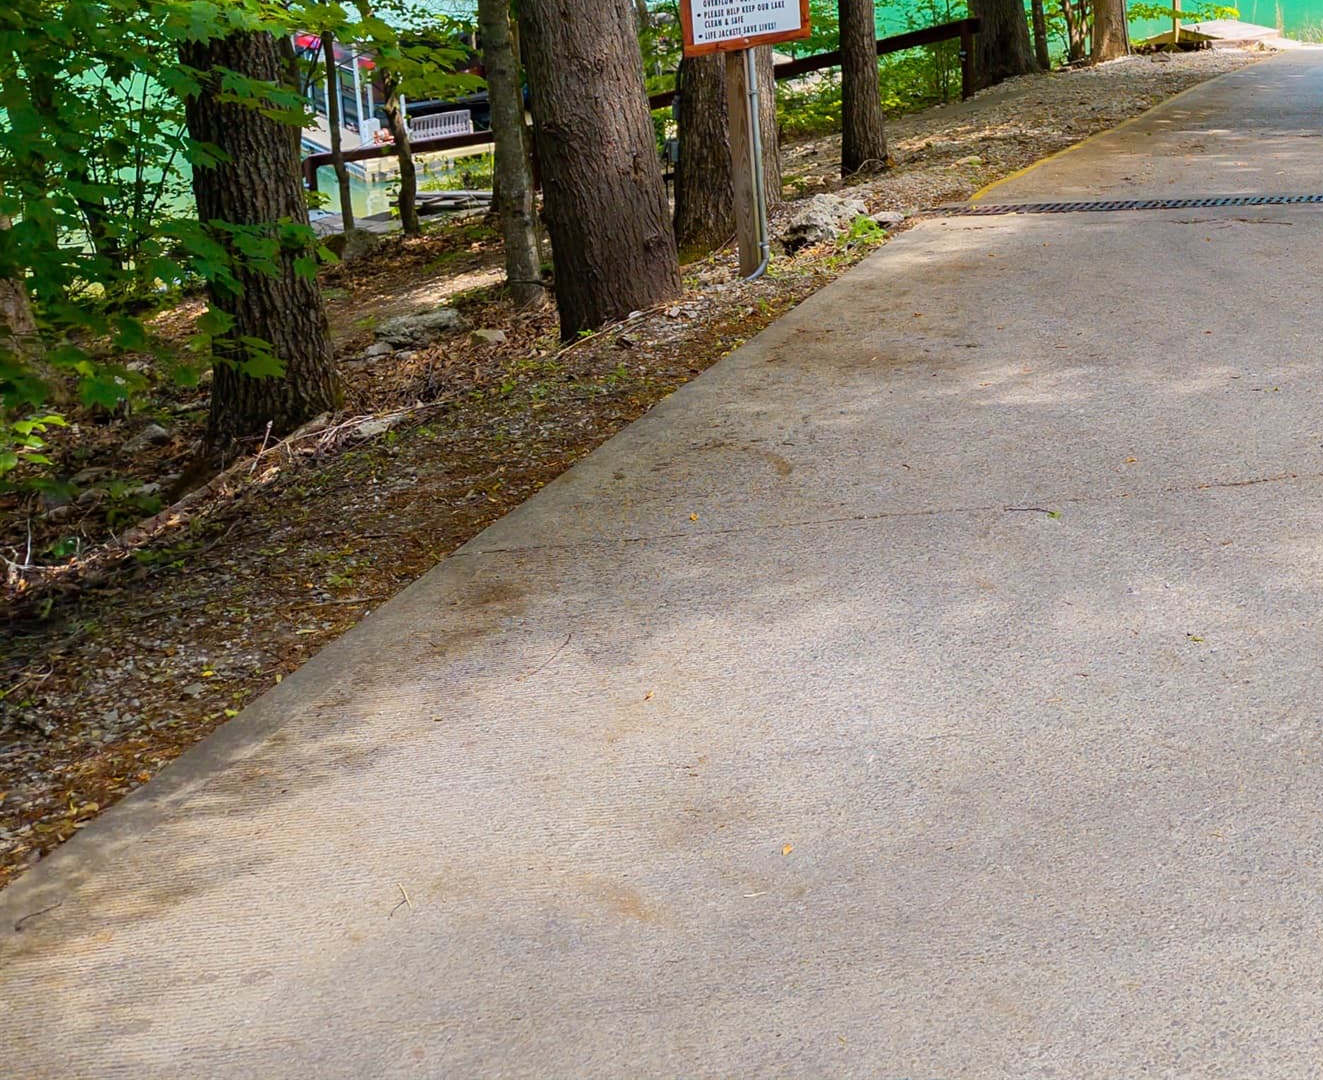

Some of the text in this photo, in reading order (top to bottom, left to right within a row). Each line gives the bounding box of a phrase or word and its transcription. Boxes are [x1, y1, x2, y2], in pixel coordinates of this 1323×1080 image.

[703, 0, 785, 20] PLEASE HELP KEEP OUR LAKE
[704, 15, 744, 30] CLEAN & SAFE
[705, 21, 777, 40] LIFE JACKETS SAVE LIVES!
